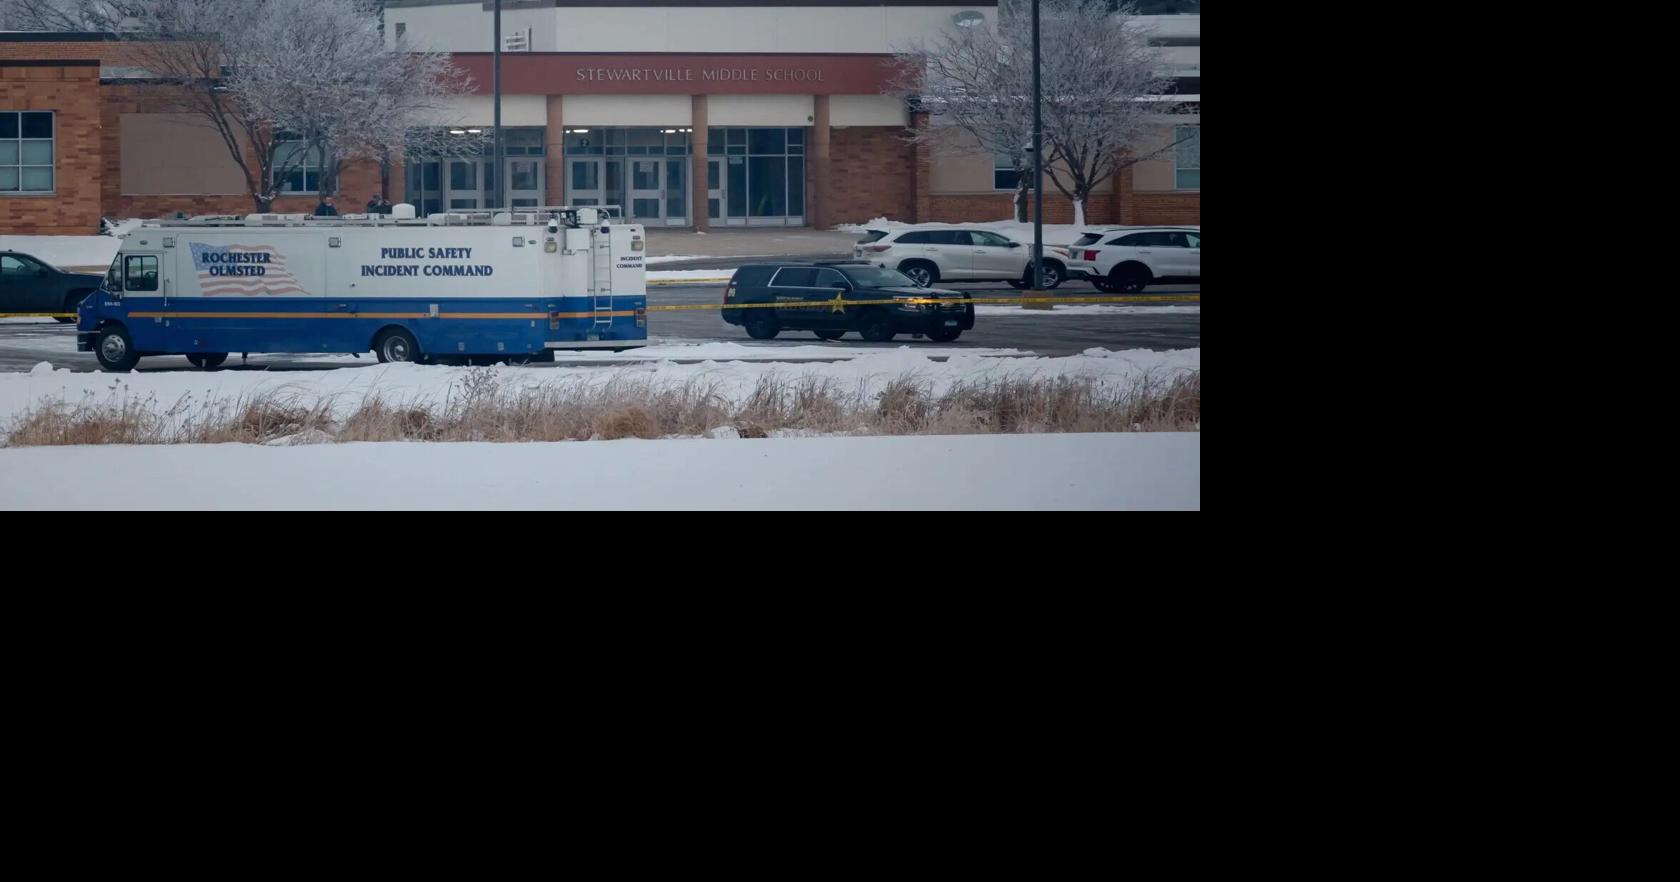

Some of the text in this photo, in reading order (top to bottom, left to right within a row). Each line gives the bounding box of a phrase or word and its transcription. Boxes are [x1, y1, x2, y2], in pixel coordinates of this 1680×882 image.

[576, 68, 825, 81] STEWARTVILLE MIDDLE SCHOOL
[202, 252, 272, 264] ROCHESTER
[381, 247, 472, 259] PUBLIC SAFETY
[209, 265, 266, 277] OLMSTED
[361, 264, 494, 277] INCIDENT COMMAND
